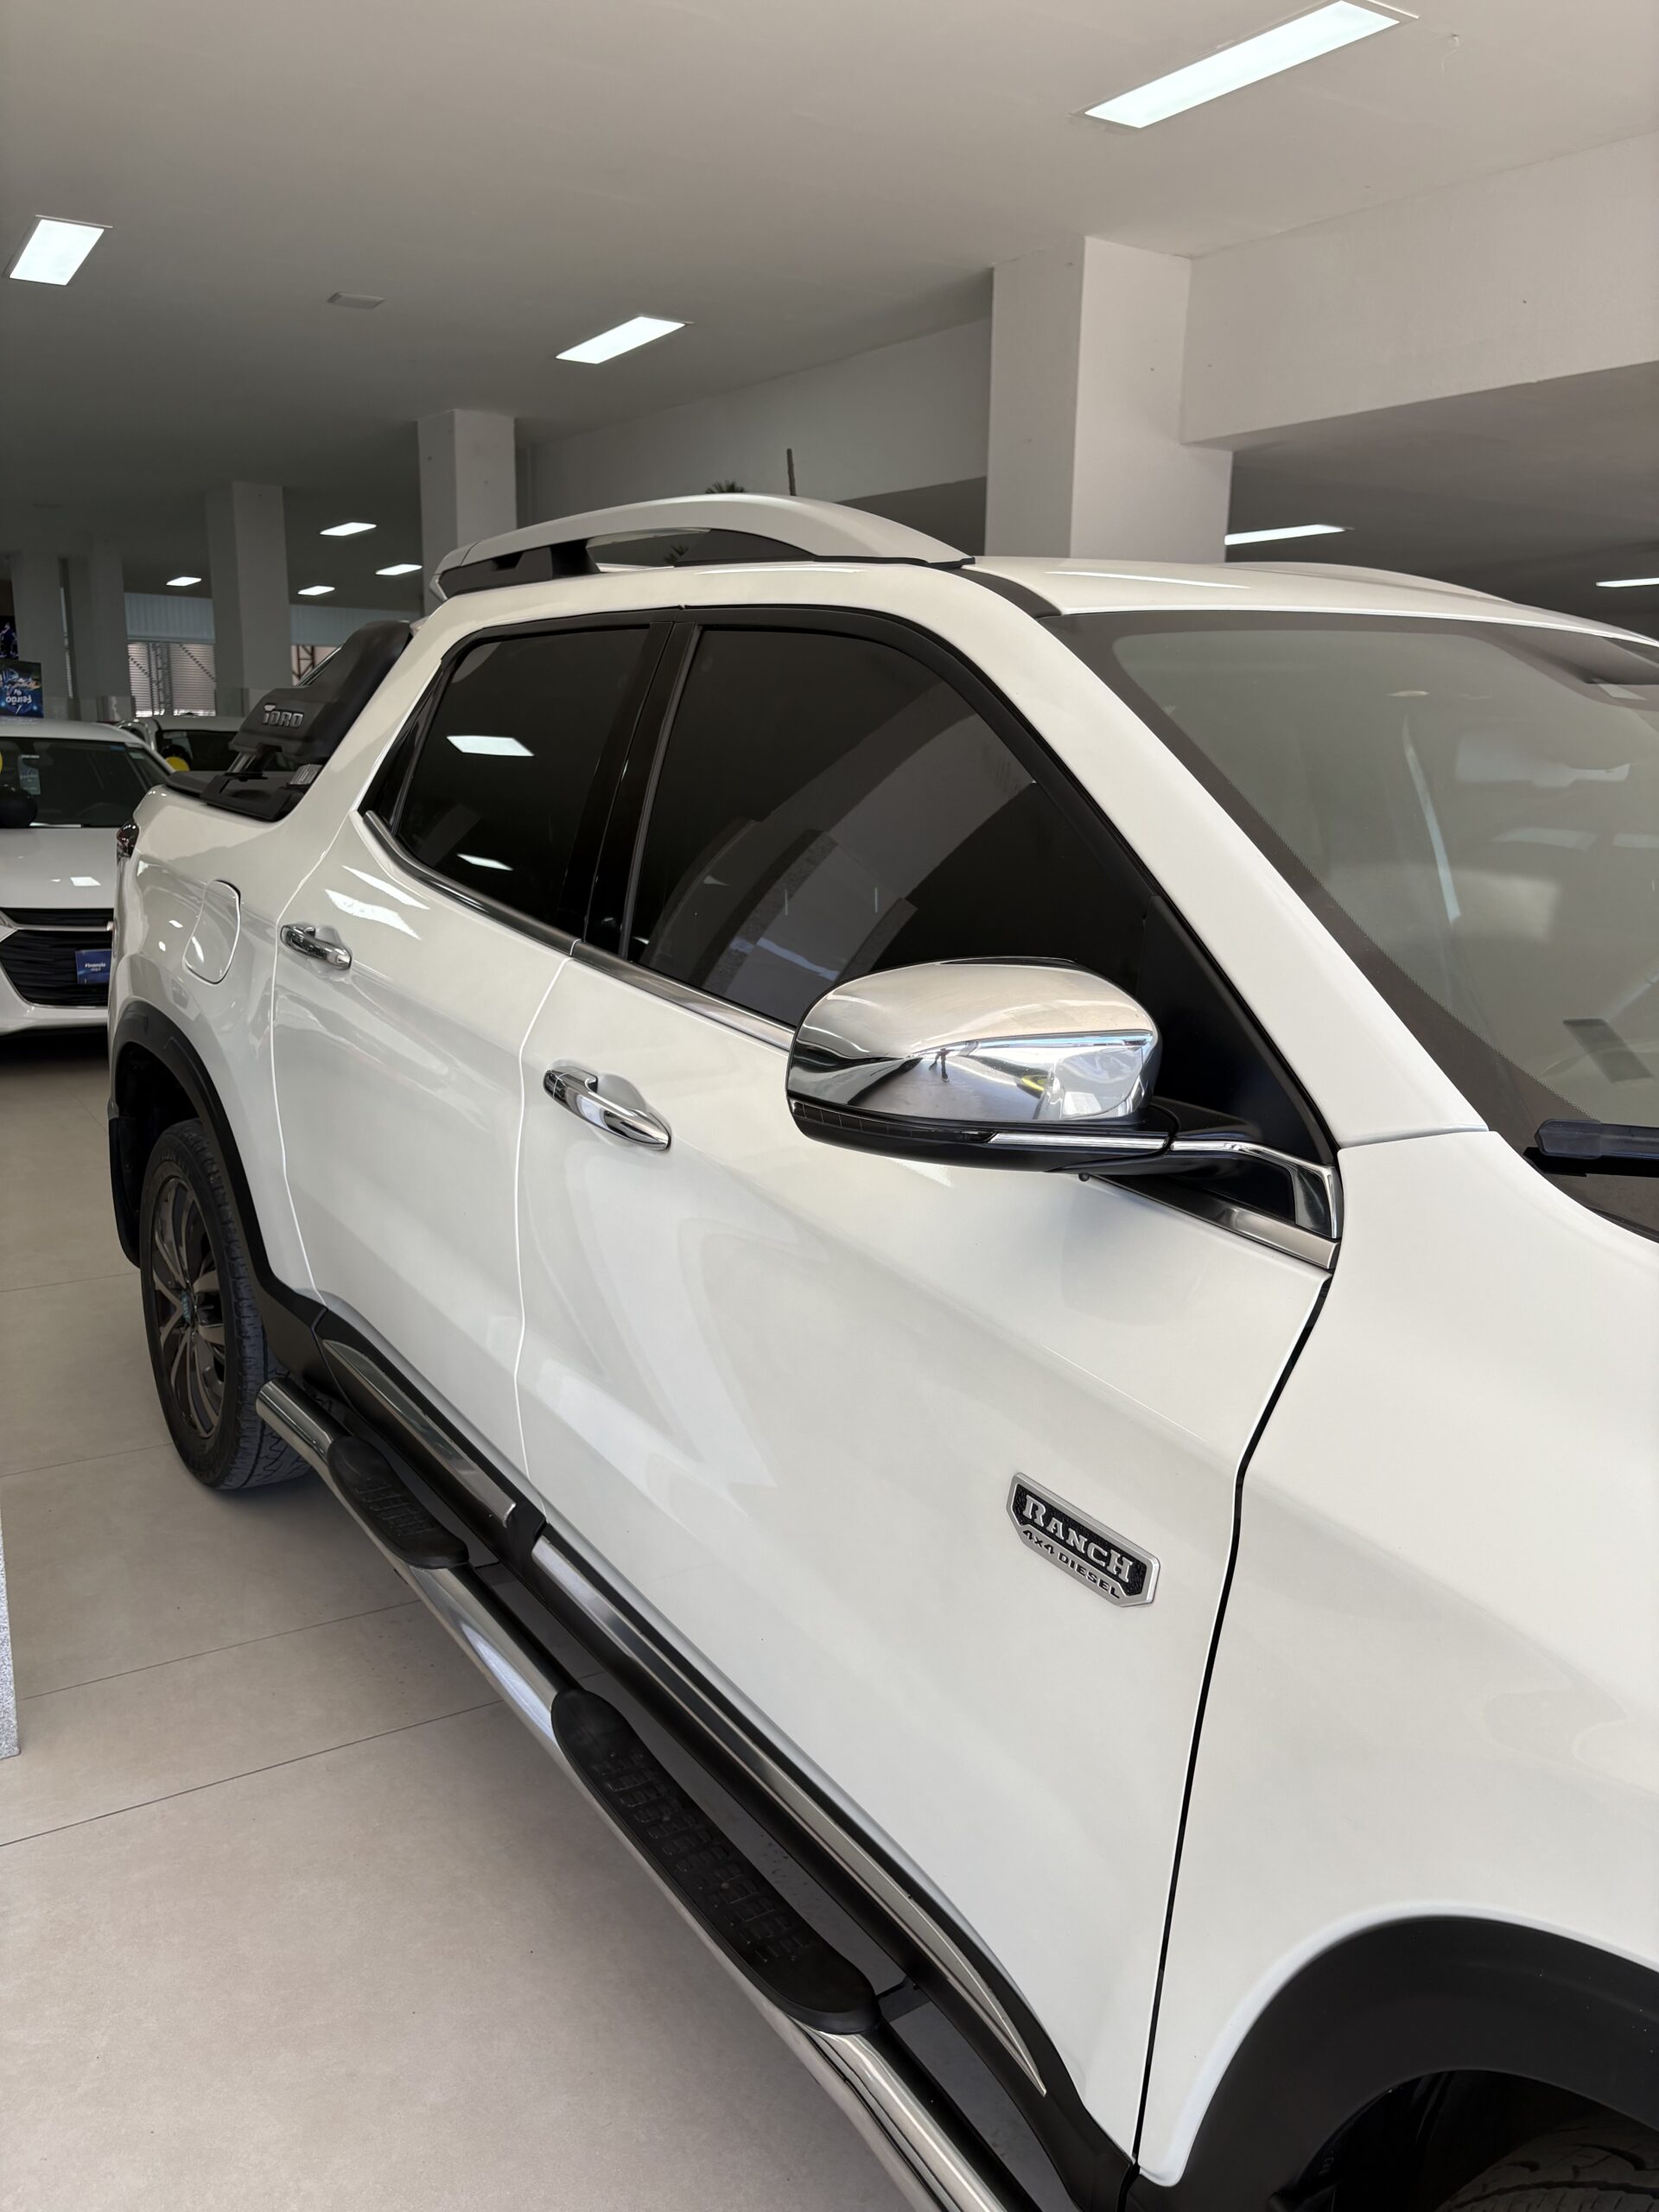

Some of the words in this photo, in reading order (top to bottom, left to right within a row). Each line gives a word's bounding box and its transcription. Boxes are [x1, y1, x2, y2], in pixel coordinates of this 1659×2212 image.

[263, 703, 304, 728] TORO
[1022, 1494, 1135, 1583] RANCH
[1057, 1551, 1121, 1600] DIESEL
